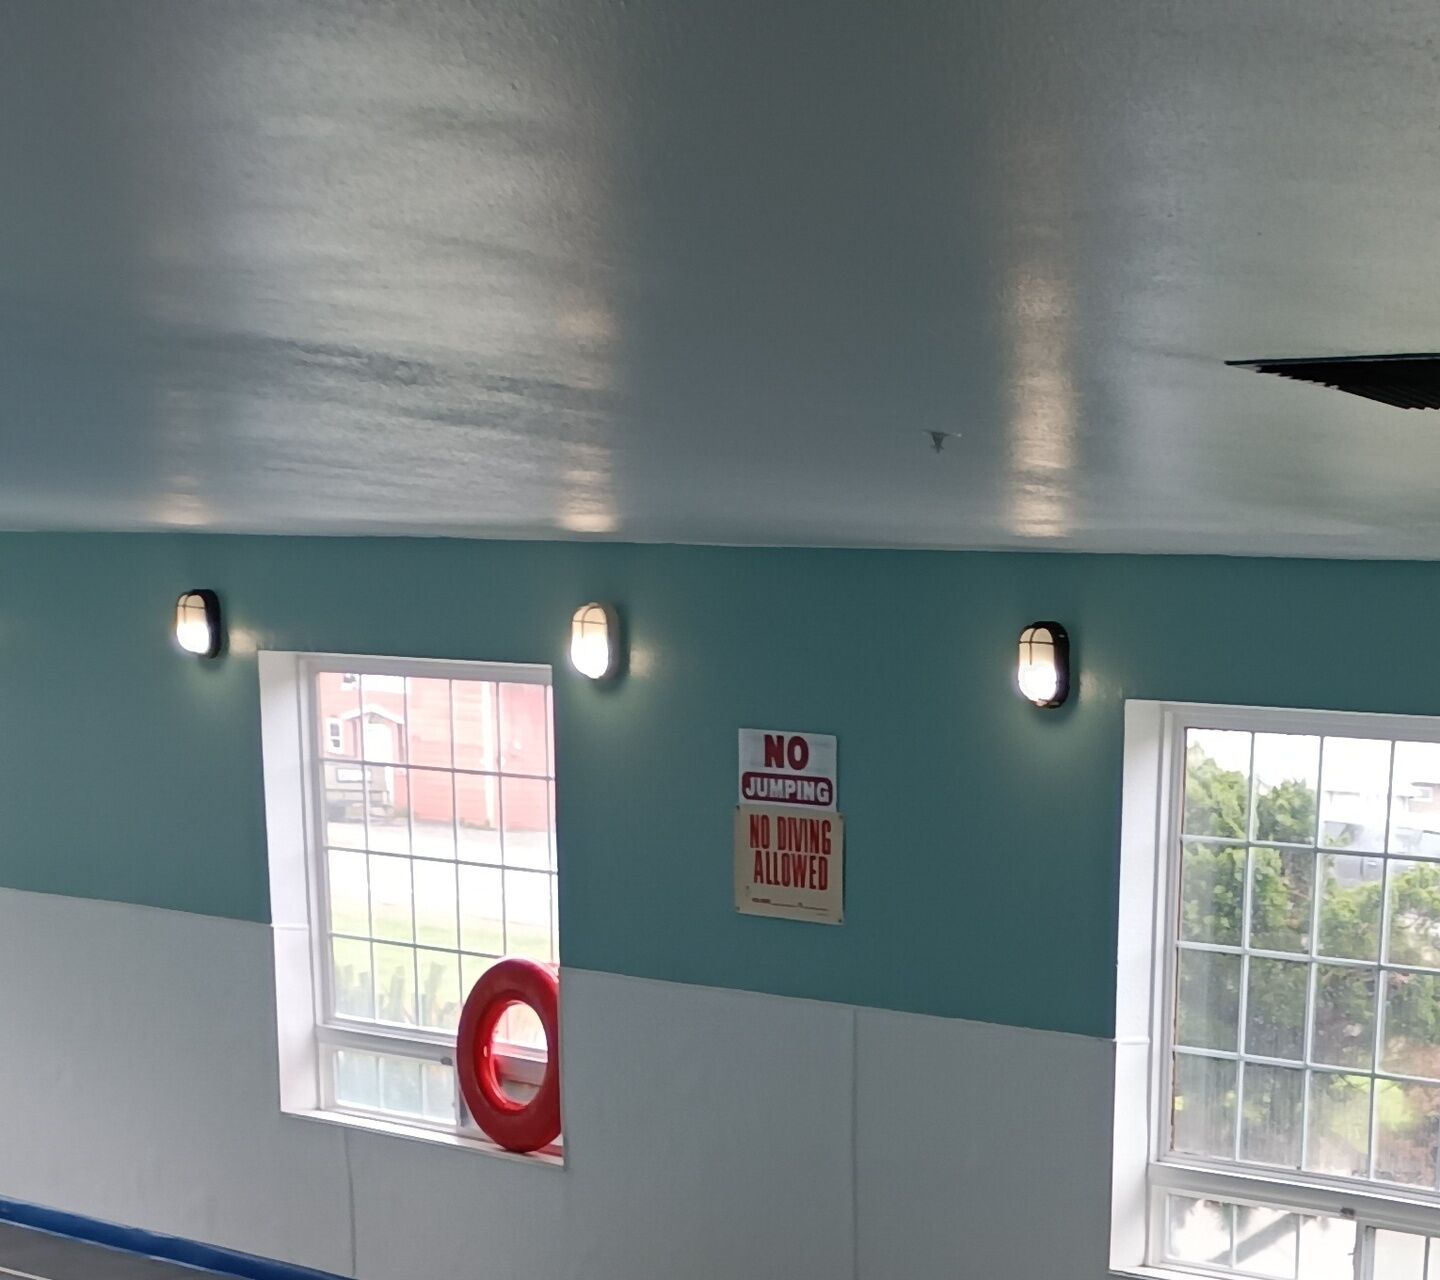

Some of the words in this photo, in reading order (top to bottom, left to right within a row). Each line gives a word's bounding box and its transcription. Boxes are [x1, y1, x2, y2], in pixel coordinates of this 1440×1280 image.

[764, 735, 809, 770] NO
[746, 777, 829, 802] JUMPING
[749, 815, 770, 849] NO
[778, 817, 831, 855] DIVING
[754, 851, 829, 890] ALLOWED
